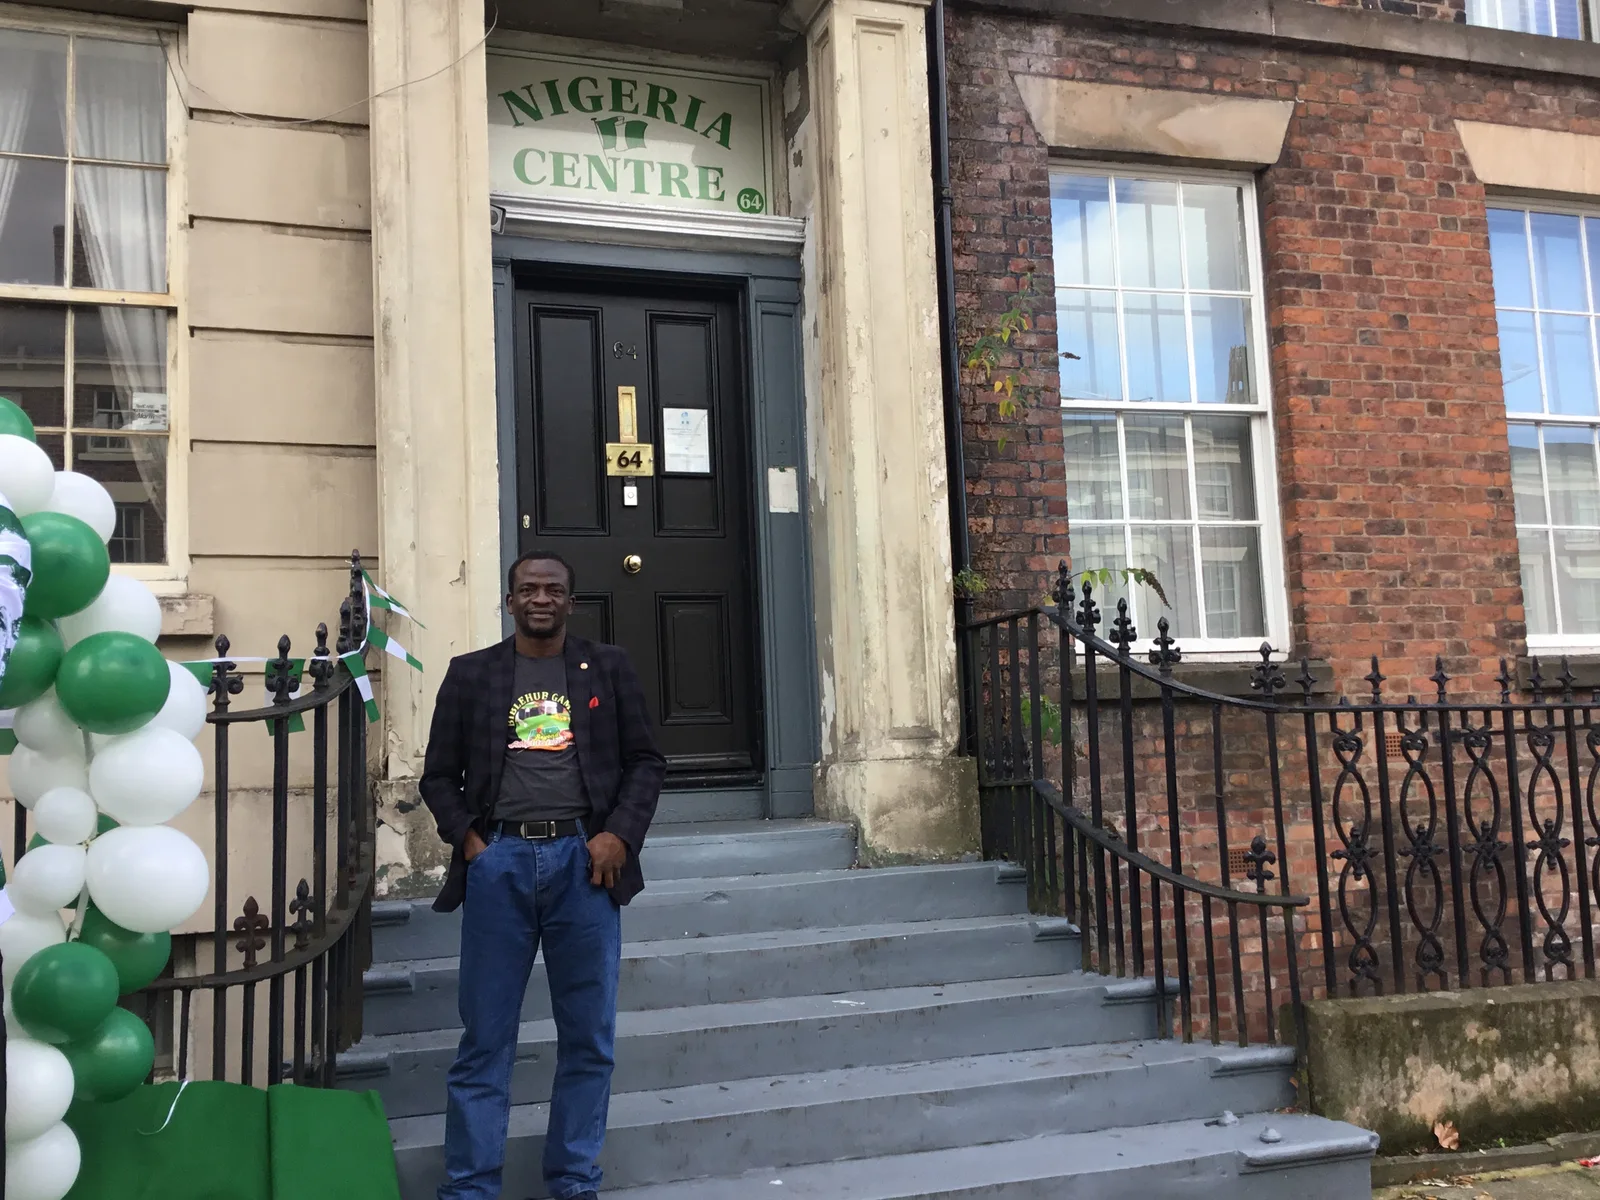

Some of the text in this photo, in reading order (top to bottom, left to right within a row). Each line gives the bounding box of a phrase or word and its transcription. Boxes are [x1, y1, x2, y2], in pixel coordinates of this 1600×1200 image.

[498, 76, 732, 150] NIGERIA
[513, 148, 726, 202] CENTRE
[740, 193, 762, 210] 64
[613, 341, 638, 360] 64
[617, 450, 643, 469] 64
[507, 691, 572, 727] BIBLEHUB GAM
